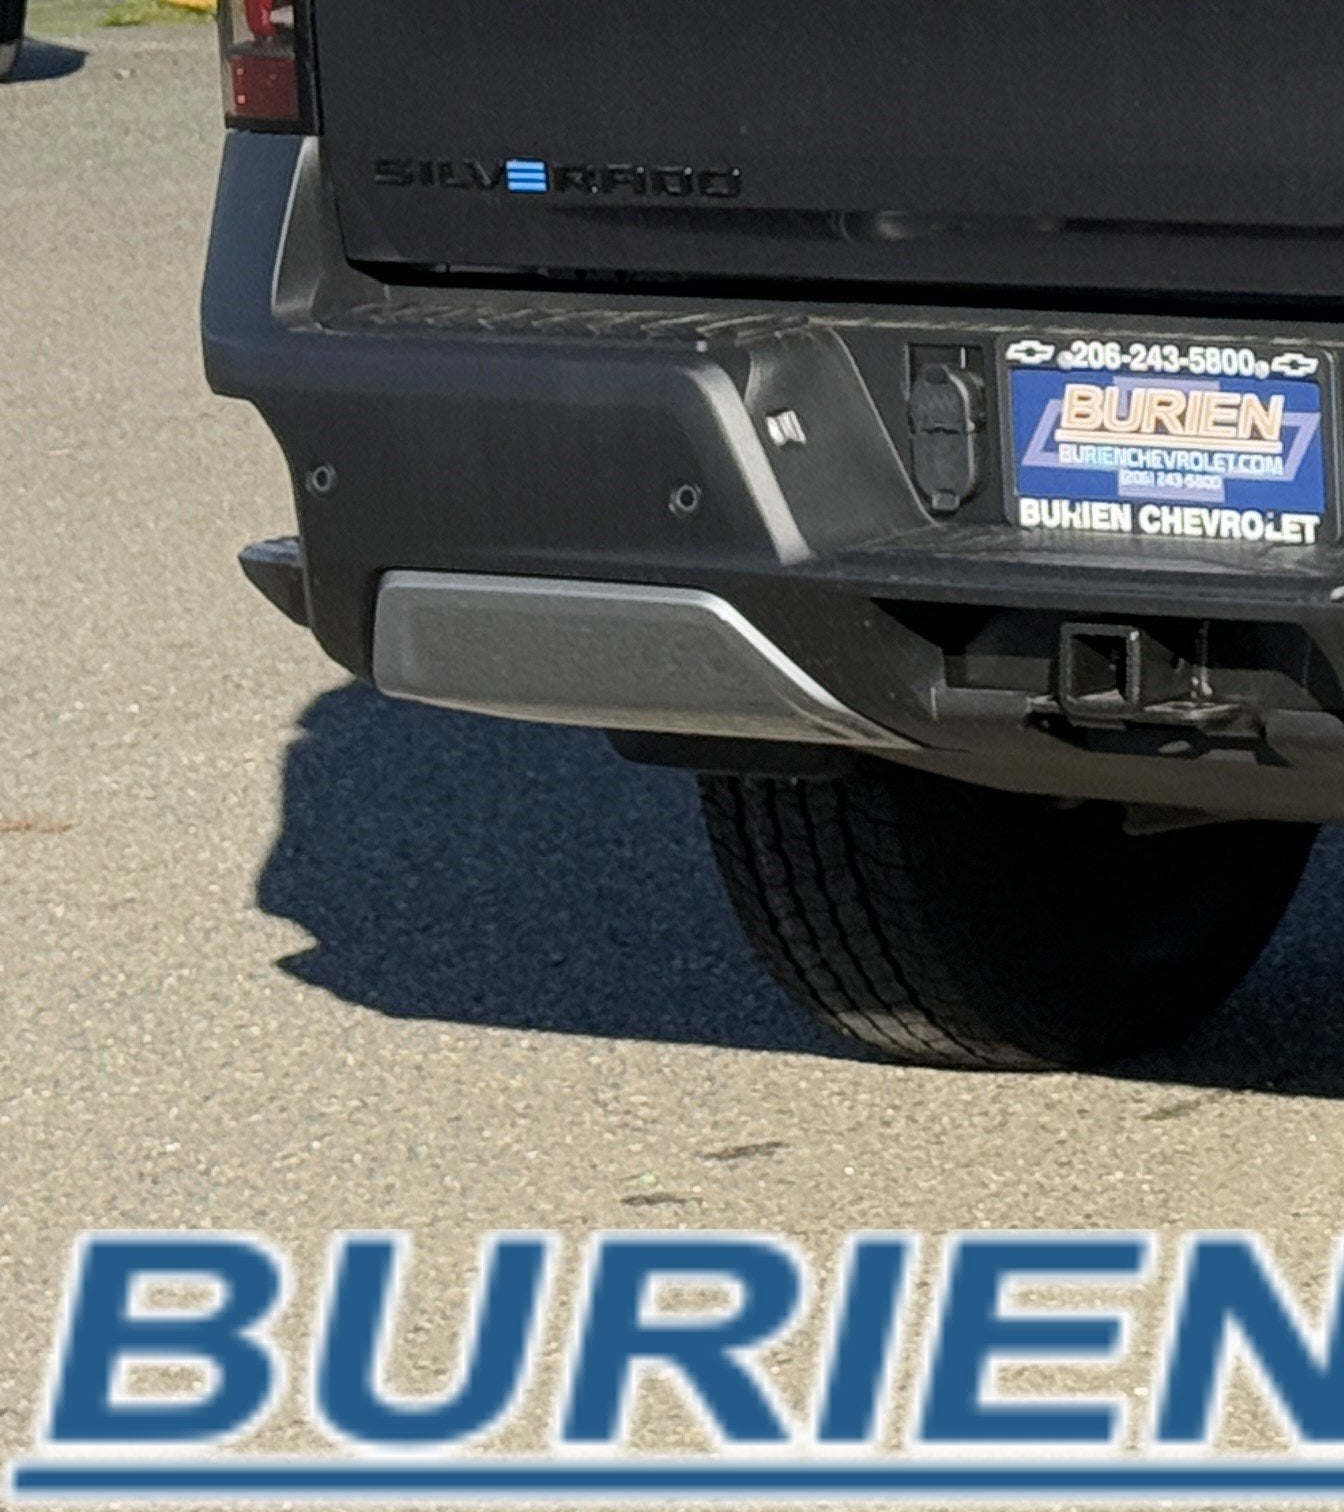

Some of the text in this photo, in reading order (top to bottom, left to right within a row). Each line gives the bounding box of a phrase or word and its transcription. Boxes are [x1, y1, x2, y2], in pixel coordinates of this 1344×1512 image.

[1070, 340, 1256, 377] 206-243-5800
[1059, 383, 1285, 440] BURIEN
[1019, 497, 1320, 544] BURIEN CHEVROLET
